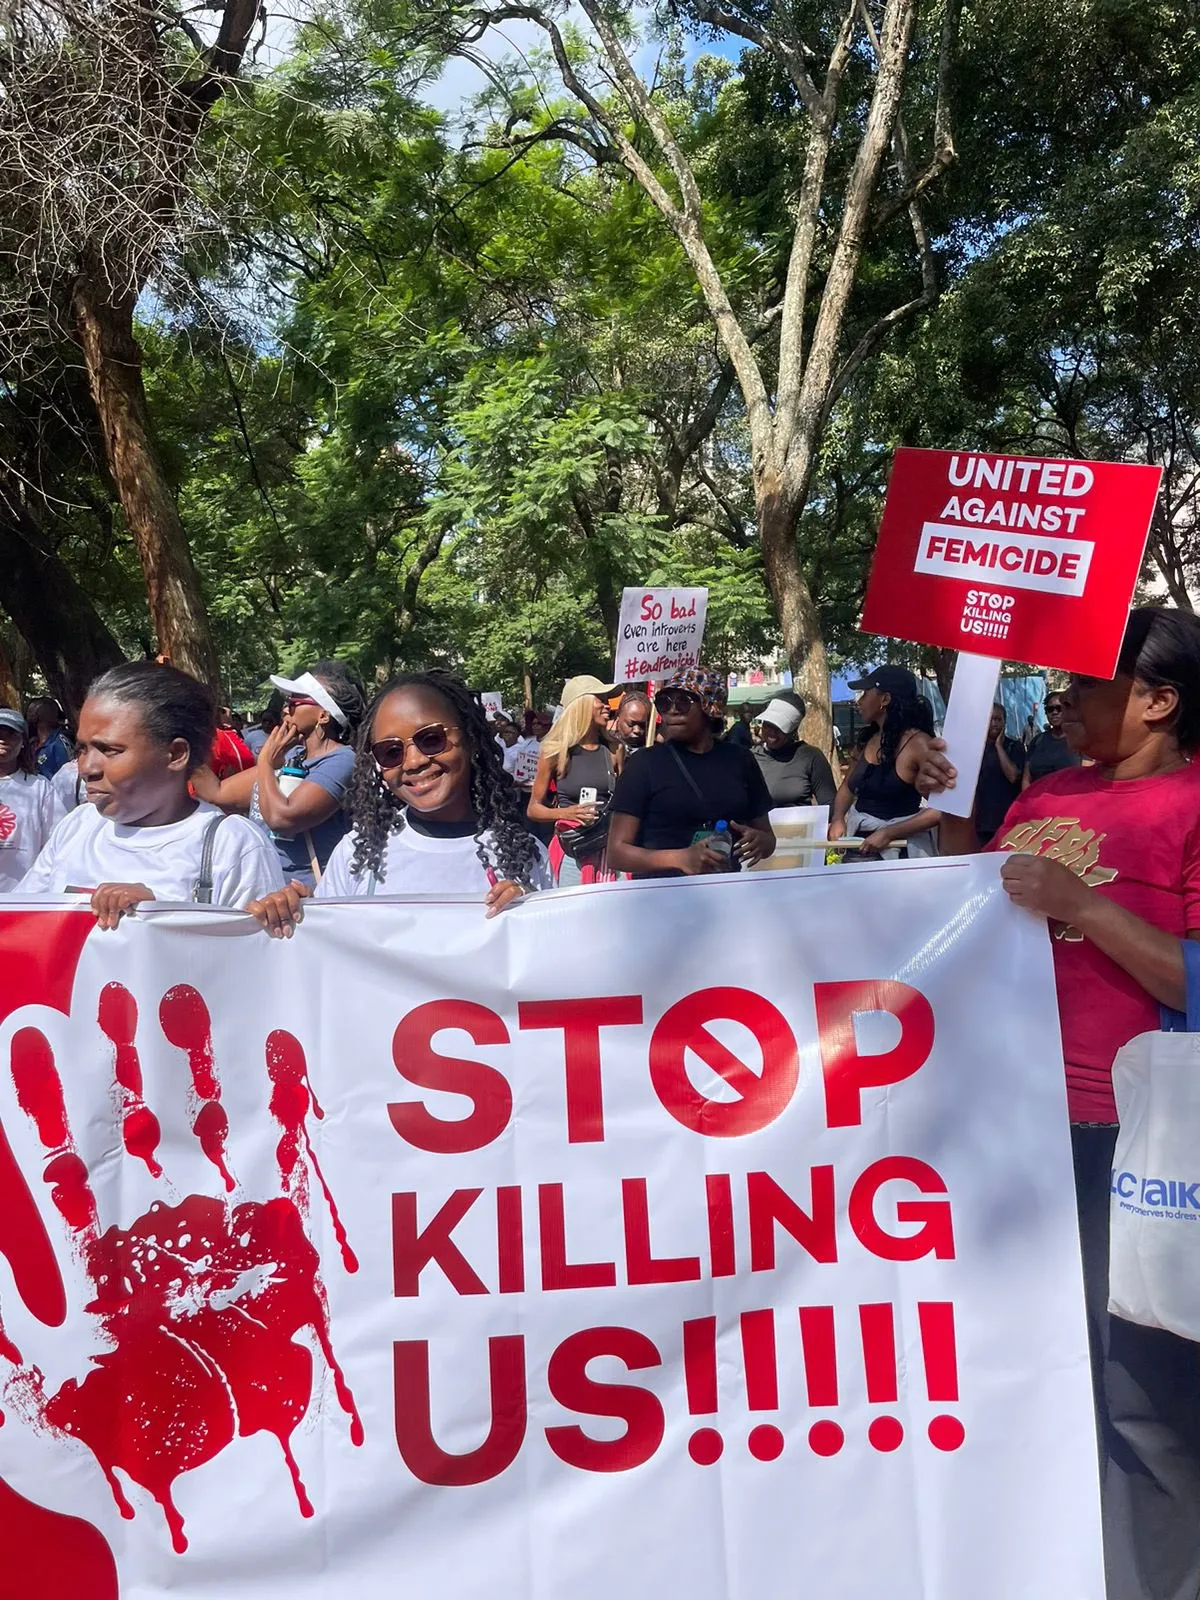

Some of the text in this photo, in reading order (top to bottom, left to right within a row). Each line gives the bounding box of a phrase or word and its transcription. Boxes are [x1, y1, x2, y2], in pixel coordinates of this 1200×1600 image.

[948, 456, 1094, 497] UNITED
[940, 496, 1086, 533] AGAINST
[925, 535, 1081, 580] FEMICIDE
[640, 594, 696, 621] So bad
[966, 589, 1015, 610] STOP
[963, 605, 1012, 624] KILLING
[624, 622, 696, 639] even introverts
[960, 617, 1009, 640] US!!!!!
[637, 638, 688, 653] are here
[386, 979, 936, 1154] STOP
[391, 1155, 957, 1298] KILLING
[1165, 1210, 1174, 1219] to
[1174, 1210, 1198, 1221] dress
[393, 1301, 966, 1487] US!!!!!
